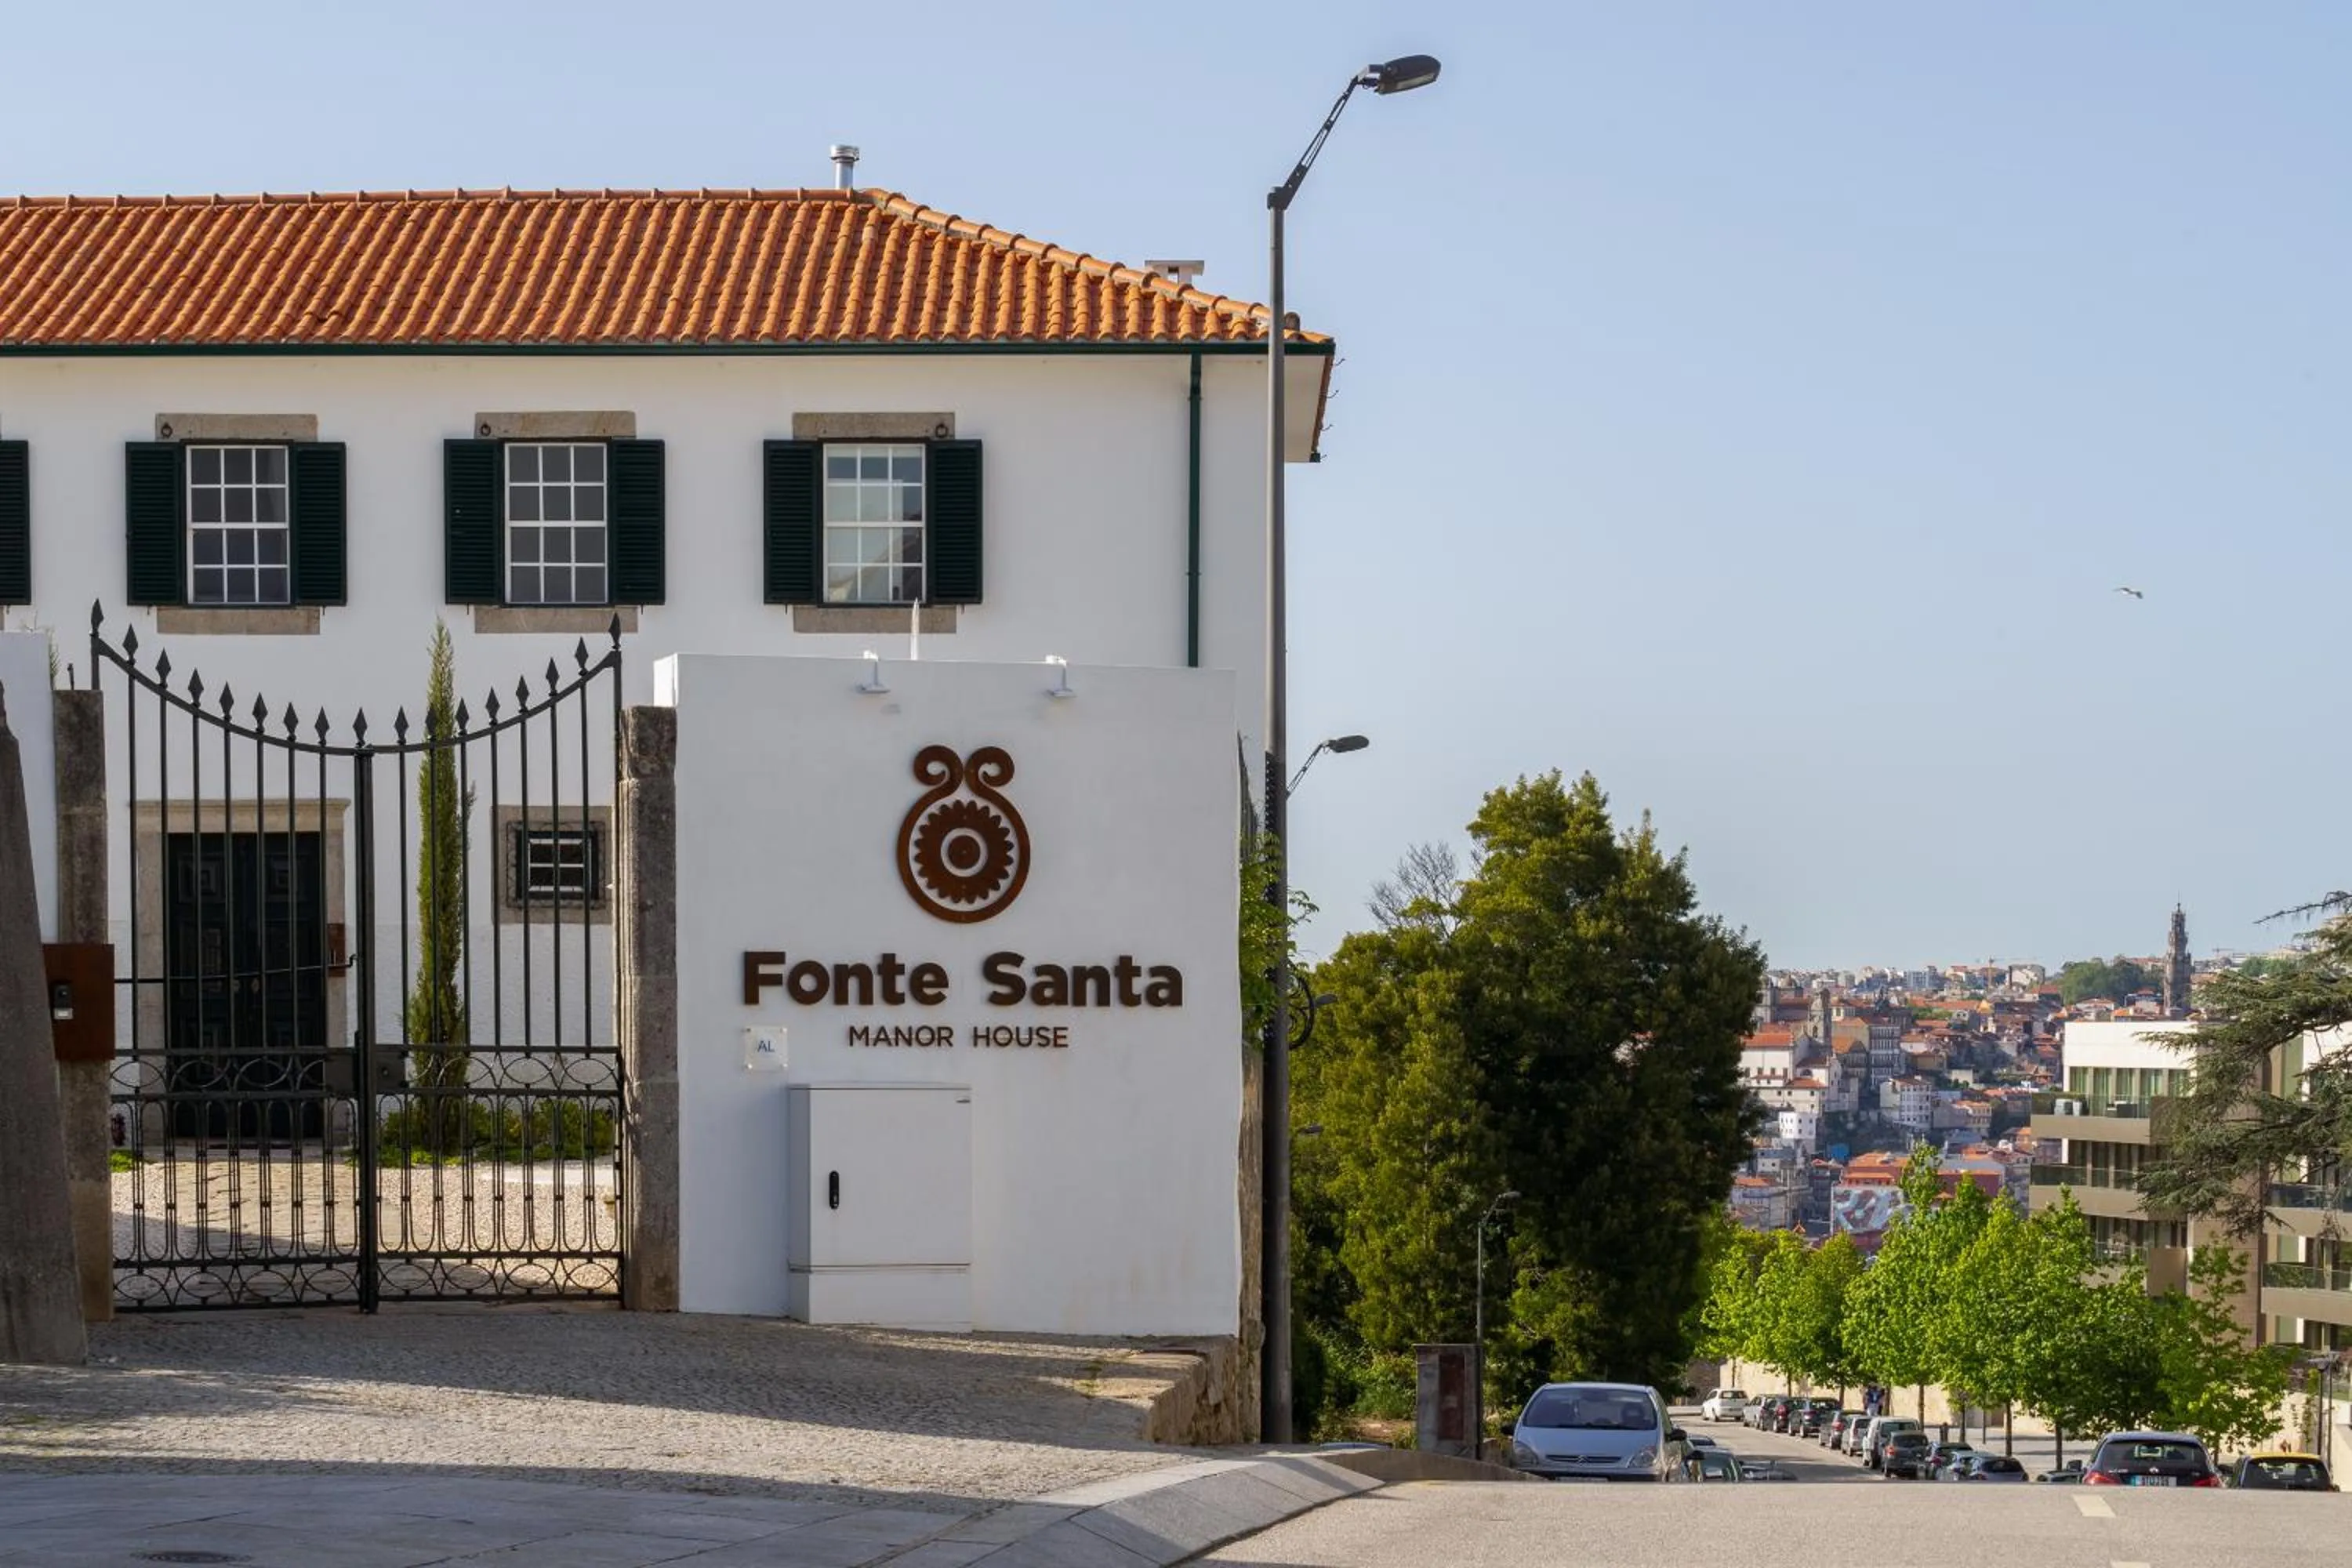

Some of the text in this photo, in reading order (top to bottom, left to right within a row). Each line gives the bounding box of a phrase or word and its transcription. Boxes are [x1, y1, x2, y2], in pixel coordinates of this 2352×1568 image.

[742, 950, 1183, 1008] Fonte Santa
[757, 1040, 775, 1053] AL
[848, 1025, 1069, 1048] MANOR HOUSE
